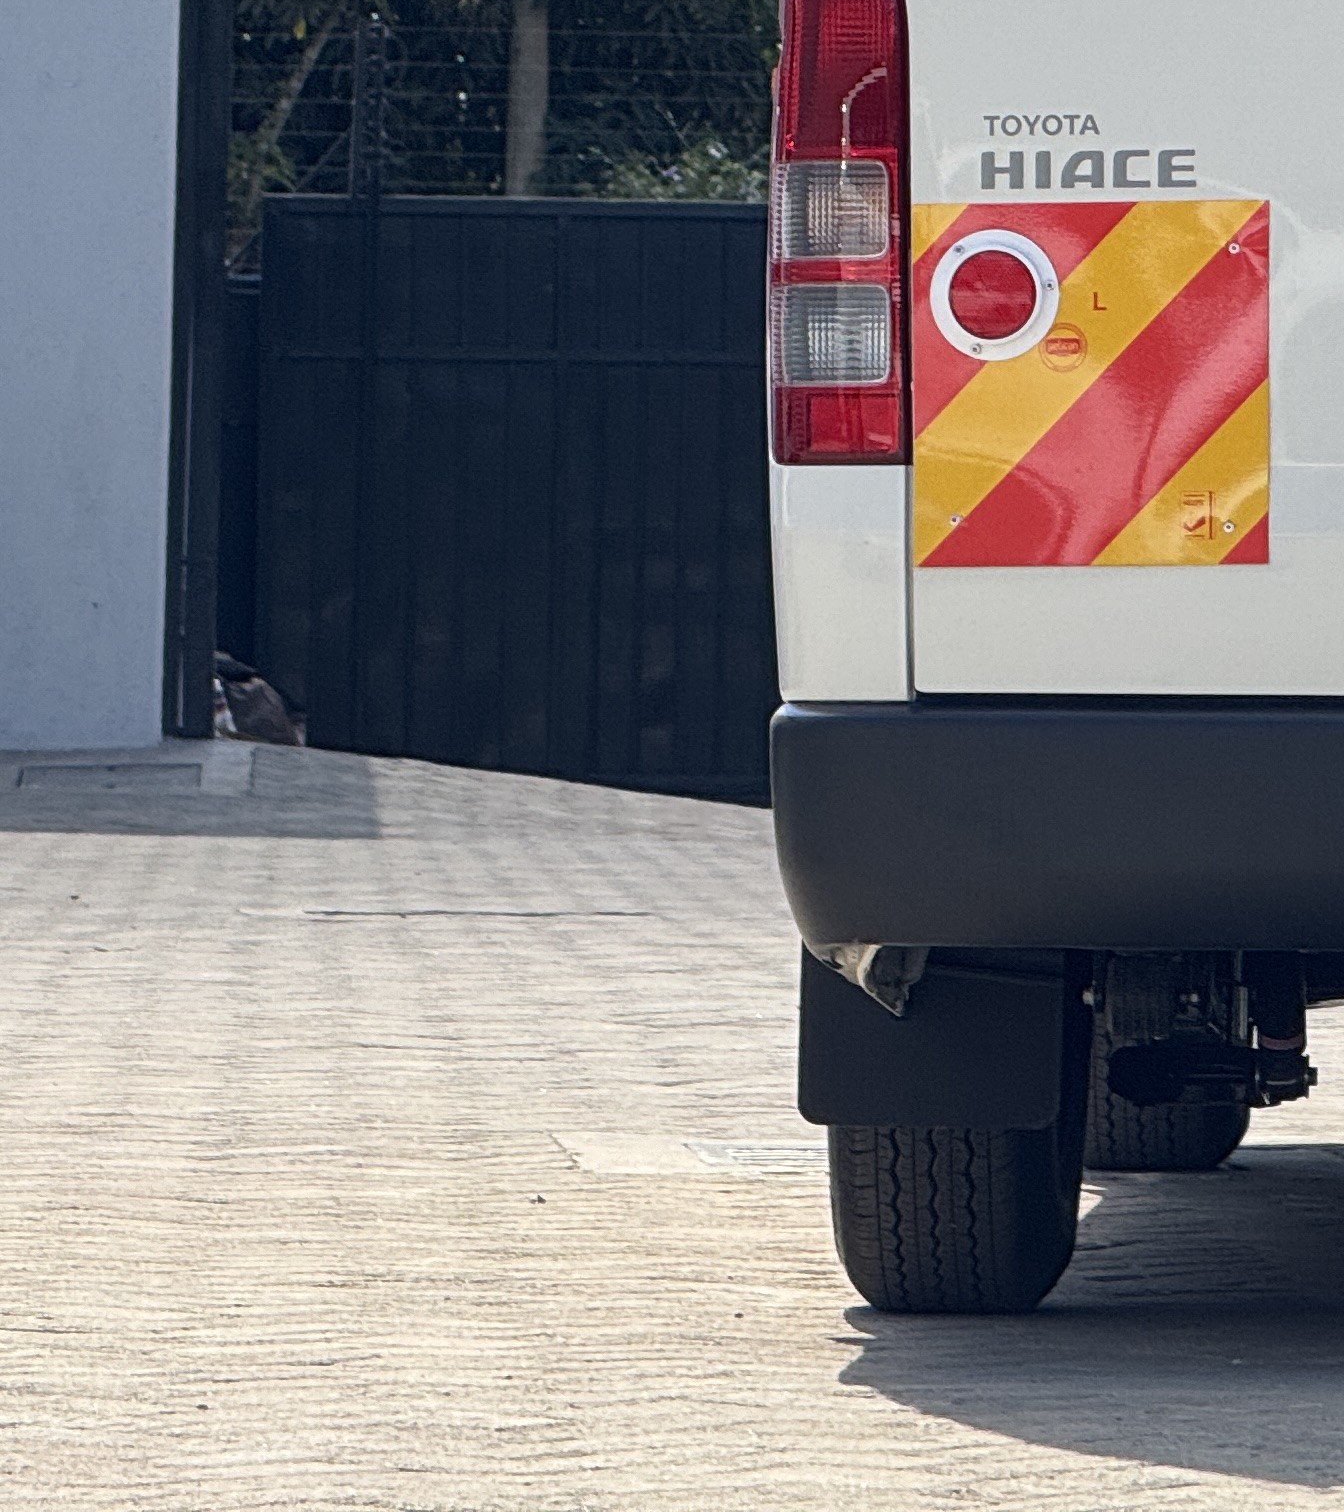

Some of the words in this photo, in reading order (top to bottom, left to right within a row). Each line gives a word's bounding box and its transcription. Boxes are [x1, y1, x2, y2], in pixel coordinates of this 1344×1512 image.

[983, 114, 1101, 136] TOYOTA
[980, 149, 1197, 190] HIACE
[1092, 292, 1107, 311] L
